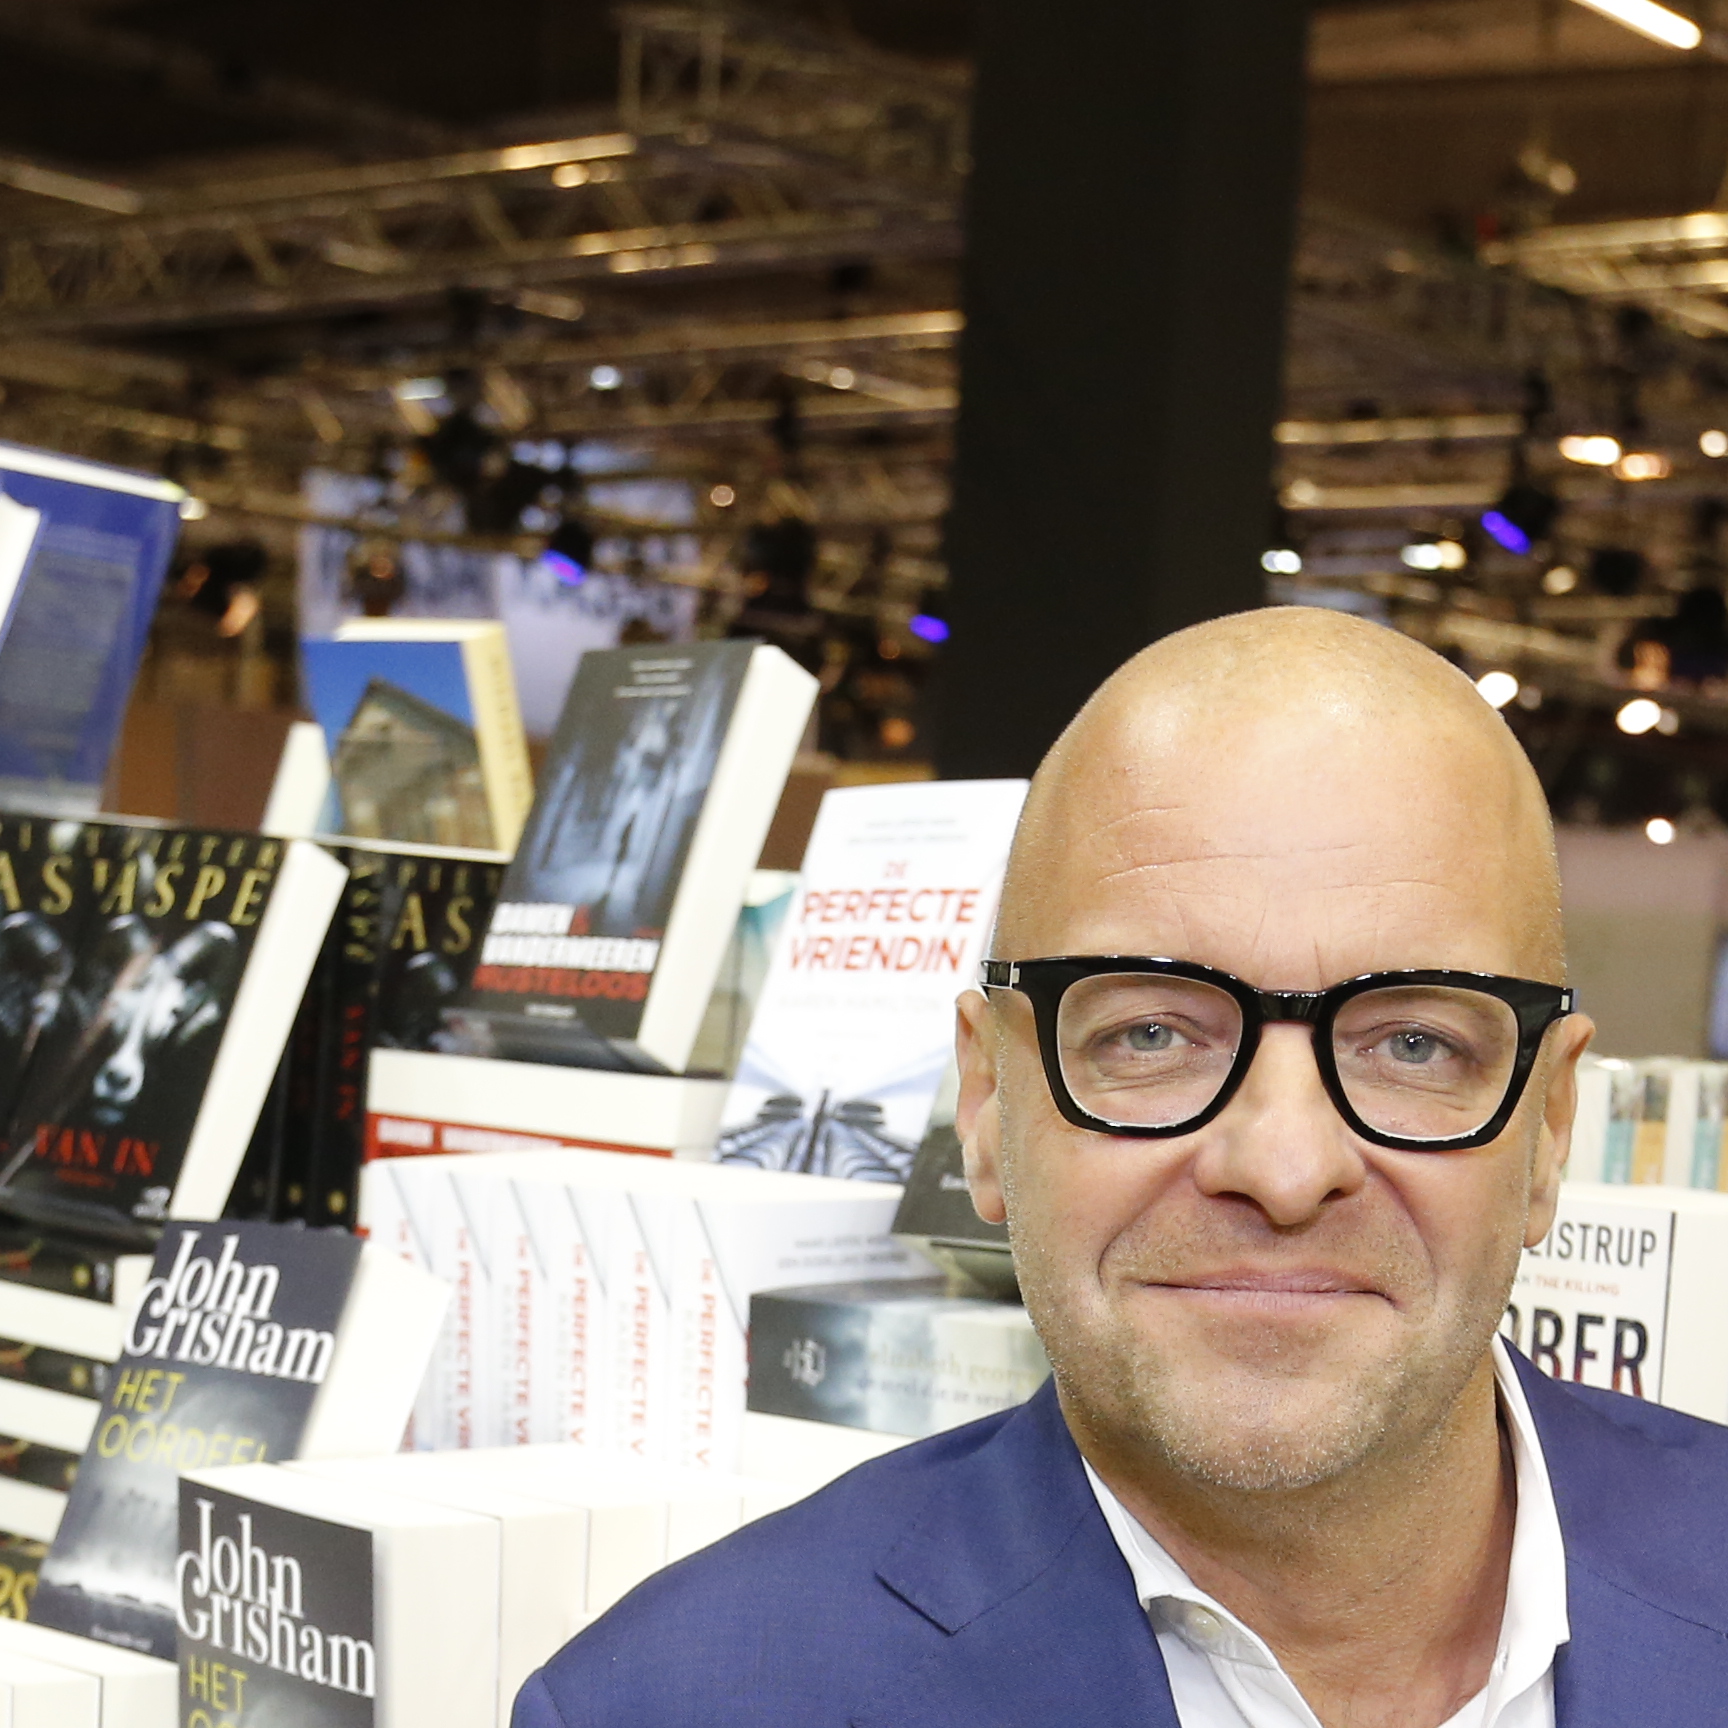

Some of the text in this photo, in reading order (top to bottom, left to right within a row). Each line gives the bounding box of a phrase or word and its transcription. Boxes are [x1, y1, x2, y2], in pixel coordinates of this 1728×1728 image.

[101, 858, 271, 926] ASPE
[800, 888, 981, 924] PERFECTE
[474, 964, 651, 1002] RUSTELOOS
[790, 936, 966, 973] VRIENDIN
[160, 1228, 280, 1322] John
[1536, 1273, 1621, 1297] THE KILLING
[124, 1277, 336, 1384] Grisham
[571, 1277, 589, 1418] PERFECTE
[632, 1285, 650, 1426] PERFECTE
[697, 1293, 717, 1438] PERFECTE
[113, 1368, 185, 1413] HET
[192, 1498, 304, 1619] John
[177, 1548, 376, 1699] Grisham
[187, 1655, 248, 1713] HET
